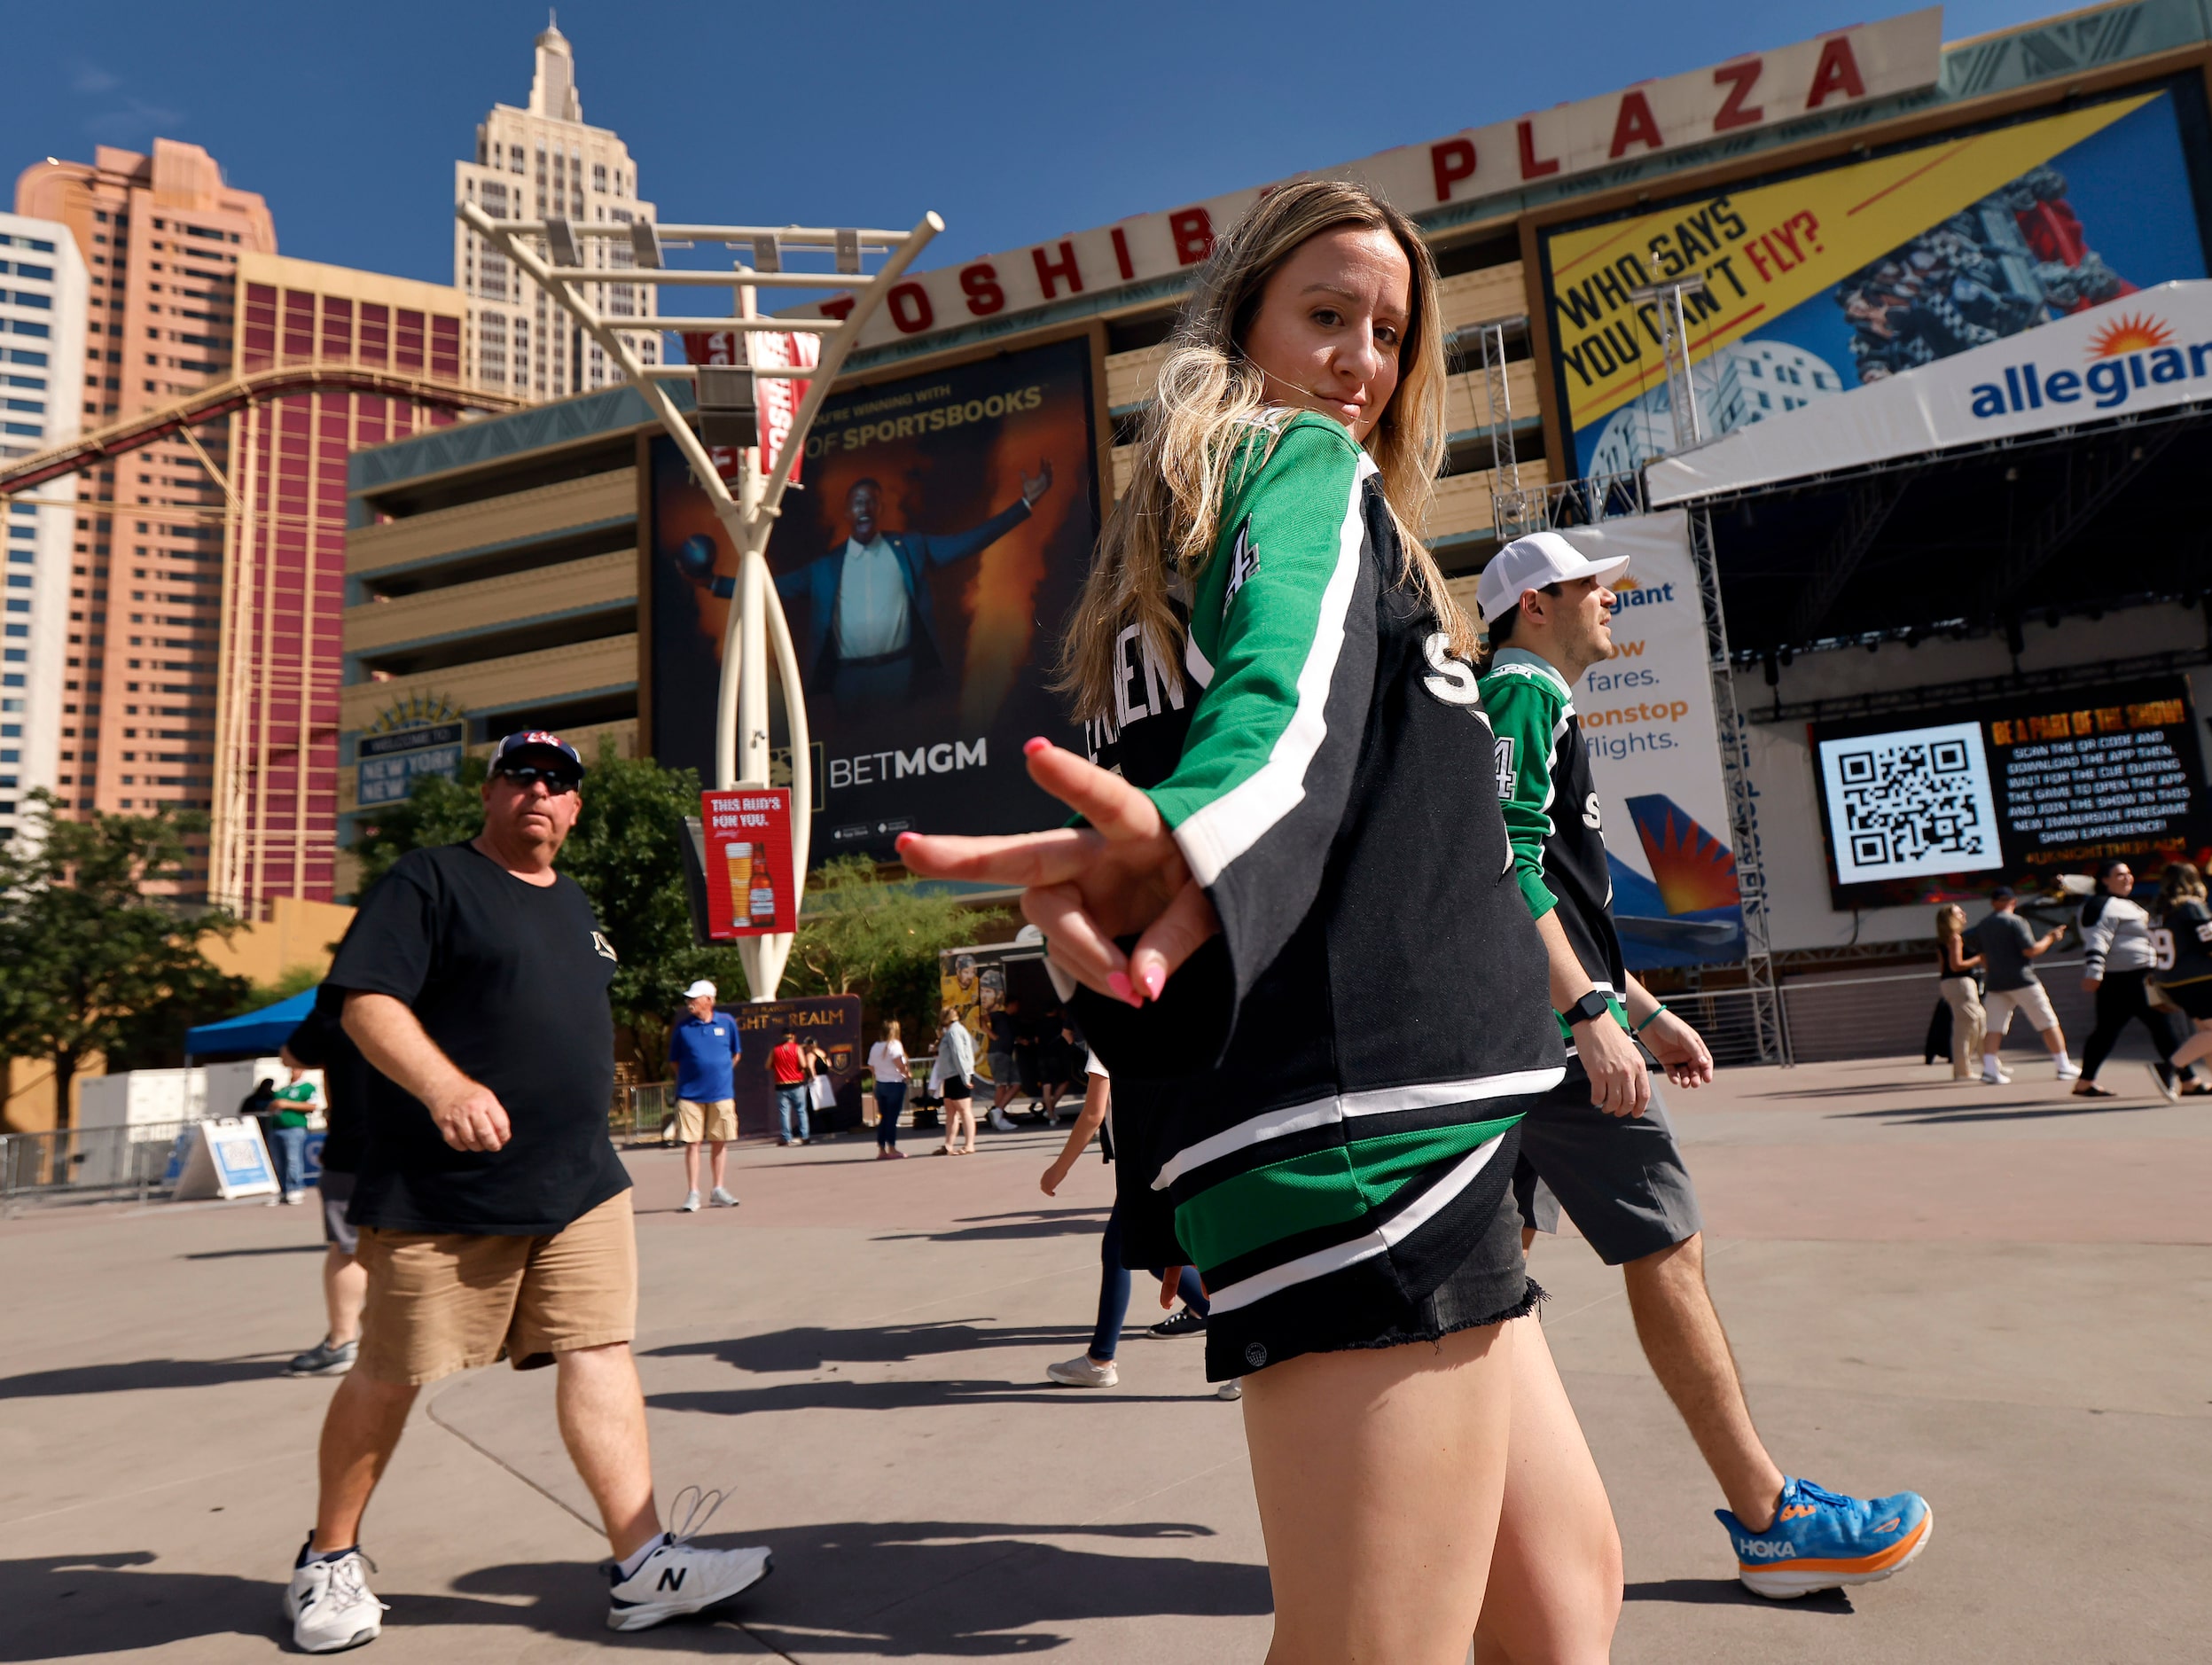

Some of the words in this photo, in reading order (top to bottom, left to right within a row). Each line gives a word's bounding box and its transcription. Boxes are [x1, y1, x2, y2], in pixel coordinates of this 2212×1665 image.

[820, 185, 1277, 347] TOSHIB
[1431, 35, 1866, 202] PLAZA
[1552, 253, 1651, 330] WHO
[1648, 195, 1747, 278] SAYS
[1561, 320, 1642, 387] YOU
[1638, 257, 1747, 345] CAN'T
[1743, 209, 1825, 284] FLY?
[813, 407, 849, 427] OU'RE
[852, 393, 913, 418] WINNING
[915, 384, 952, 404] WITH
[804, 433, 839, 459] OF
[843, 386, 1043, 450] SPORTSBOOKS
[1610, 582, 1675, 614] giant
[1608, 640, 1645, 660] ow
[1588, 668, 1660, 692] fares.
[1578, 700, 1689, 730] nonstop
[2016, 718, 2028, 742] A
[2072, 710, 2092, 735] OF
[1587, 732, 1678, 760] flights.
[2013, 746, 2049, 760] SCAN
[2050, 741, 2075, 755] THE
[2075, 739, 2096, 753] QR
[2097, 733, 2133, 749] CODE
[2135, 730, 2164, 744] AND
[362, 760, 406, 781] NEW
[409, 748, 457, 774] YORK
[830, 737, 989, 788] BETMGM
[1493, 737, 1517, 801] 4
[2006, 755, 2080, 775] DOWNLOAD
[2081, 752, 2106, 765] THE
[2107, 748, 2136, 762] APP
[2007, 774, 2041, 789] WAIT
[2043, 771, 2069, 785] FOR
[2071, 768, 2096, 780] THE
[2098, 764, 2125, 778] CUE
[2126, 758, 2181, 776] DURING
[361, 779, 406, 801] NEW
[2007, 791, 2032, 803] THE
[2033, 786, 2073, 801] GAME
[2074, 783, 2092, 795] TO
[2092, 780, 2129, 794] OPEN
[2130, 775, 2156, 789] THE
[2157, 772, 2186, 786] APP
[2007, 804, 2036, 817] AND
[2037, 801, 2068, 815] JOIN
[2069, 797, 2095, 810] THE
[2095, 793, 2137, 809] SHOW
[2138, 791, 2155, 803] IN
[2156, 786, 2191, 801] THIS
[711, 798, 741, 813] THIS
[739, 814, 770, 827] YOU.
[2013, 818, 2044, 832] NEW
[2044, 809, 2122, 829] IMMERSIVE
[2123, 801, 2189, 820] PREGAME
[2038, 829, 2079, 844] SHOW
[736, 1014, 770, 1031] GHT
[788, 1009, 845, 1028] REALM
[1739, 1538, 1797, 1558] HOKA
[657, 1567, 687, 1591] N
